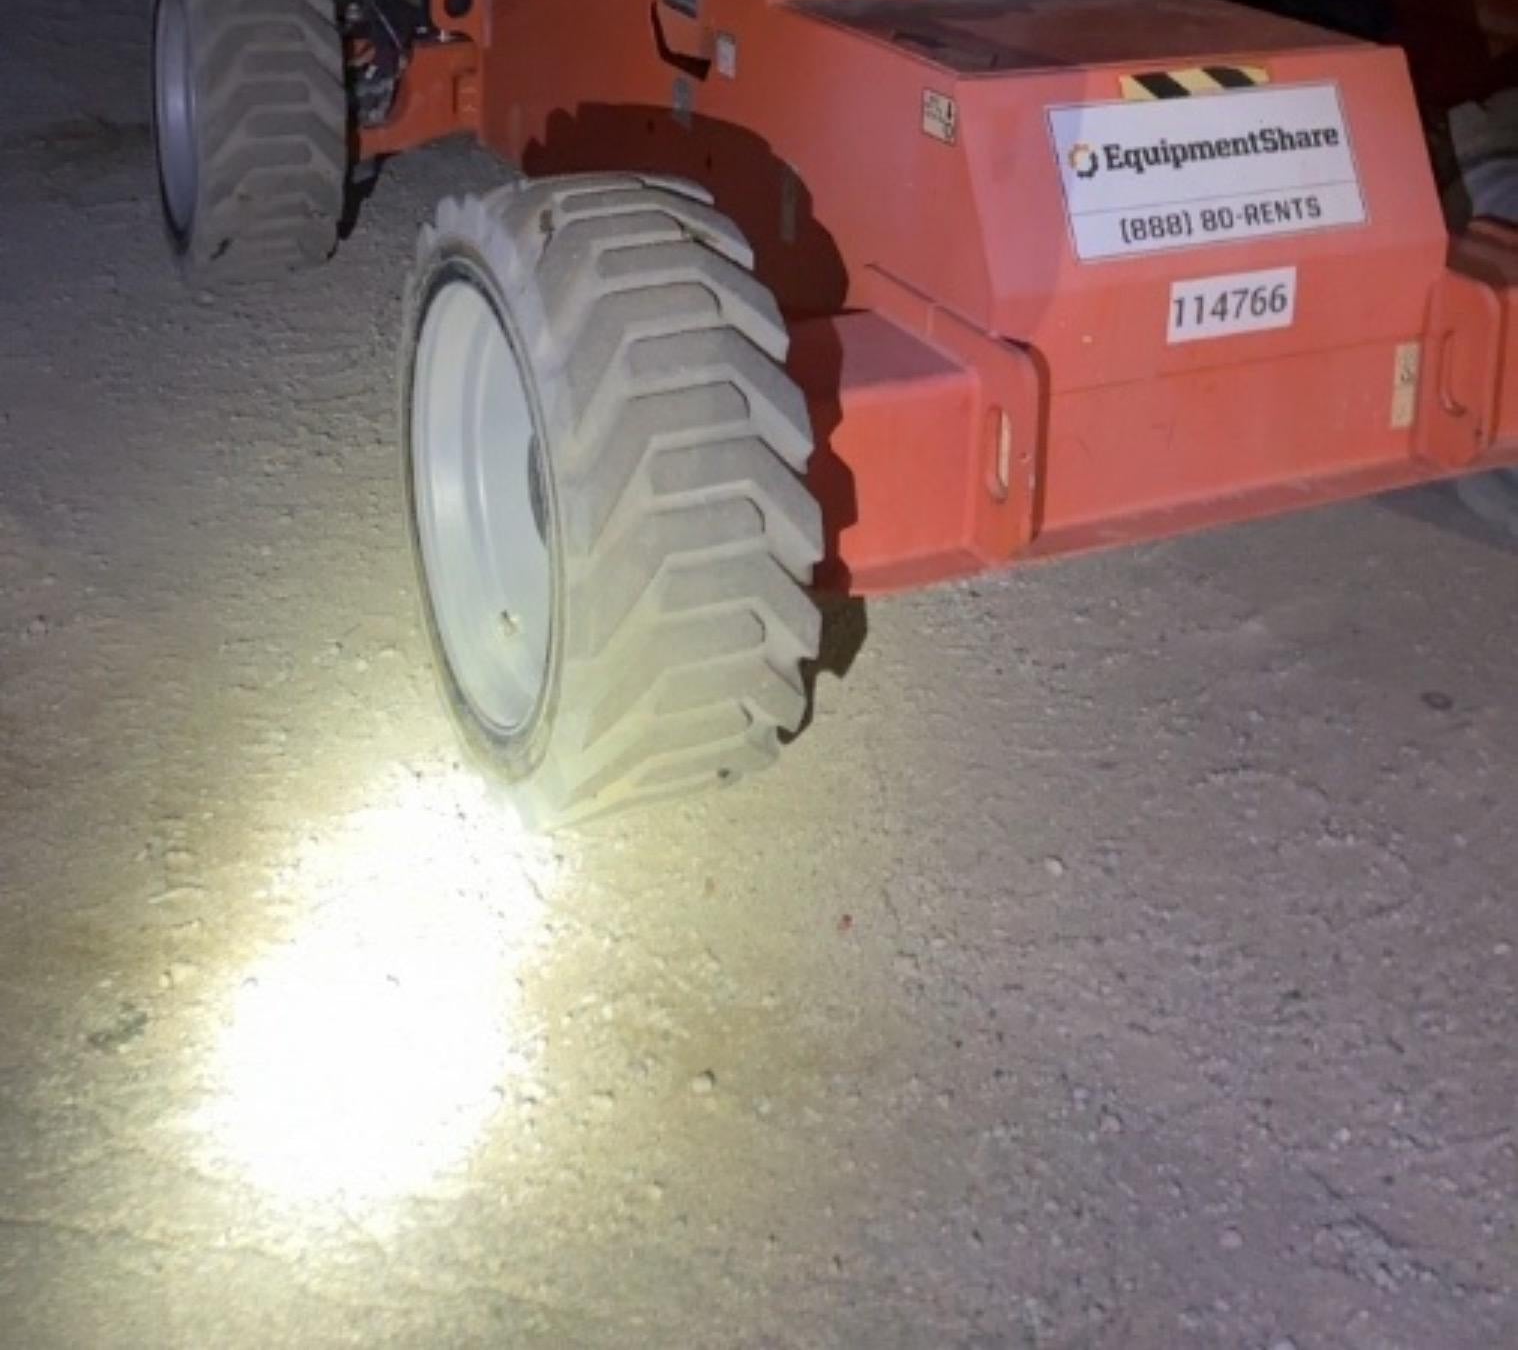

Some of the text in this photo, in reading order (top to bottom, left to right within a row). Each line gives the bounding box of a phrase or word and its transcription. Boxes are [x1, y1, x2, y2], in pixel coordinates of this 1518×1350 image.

[1102, 126, 1340, 174] EquipmentShare
[1119, 195, 1322, 244] (888) 80-RENTS
[1173, 283, 1288, 329] 114766
